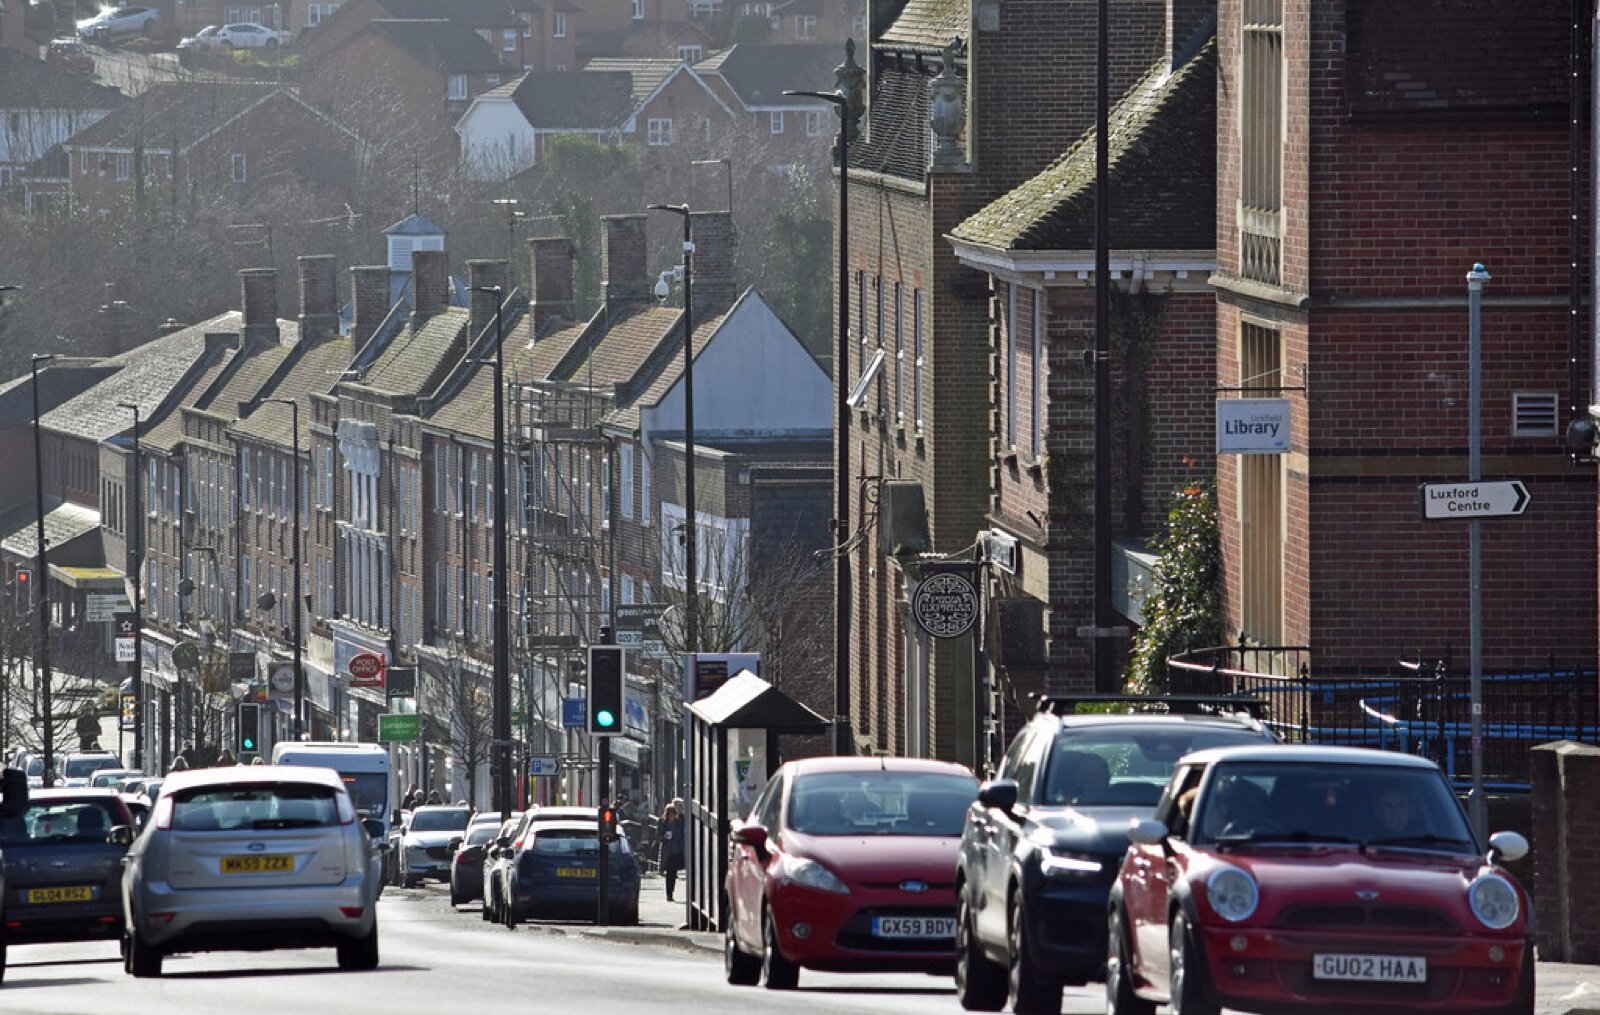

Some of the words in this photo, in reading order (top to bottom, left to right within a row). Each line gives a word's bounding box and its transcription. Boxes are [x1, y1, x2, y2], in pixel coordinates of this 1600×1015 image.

[1225, 420, 1279, 437] Library
[1430, 487, 1479, 499] Luxford
[1447, 500, 1490, 512] Centre
[931, 596, 962, 604] PIZZA
[355, 658, 375, 666] POST
[351, 665, 377, 673] OFFICE
[882, 919, 921, 934] GX59
[926, 920, 954, 935] BDY
[1322, 957, 1374, 977] GU02
[1380, 959, 1417, 978] HAA
